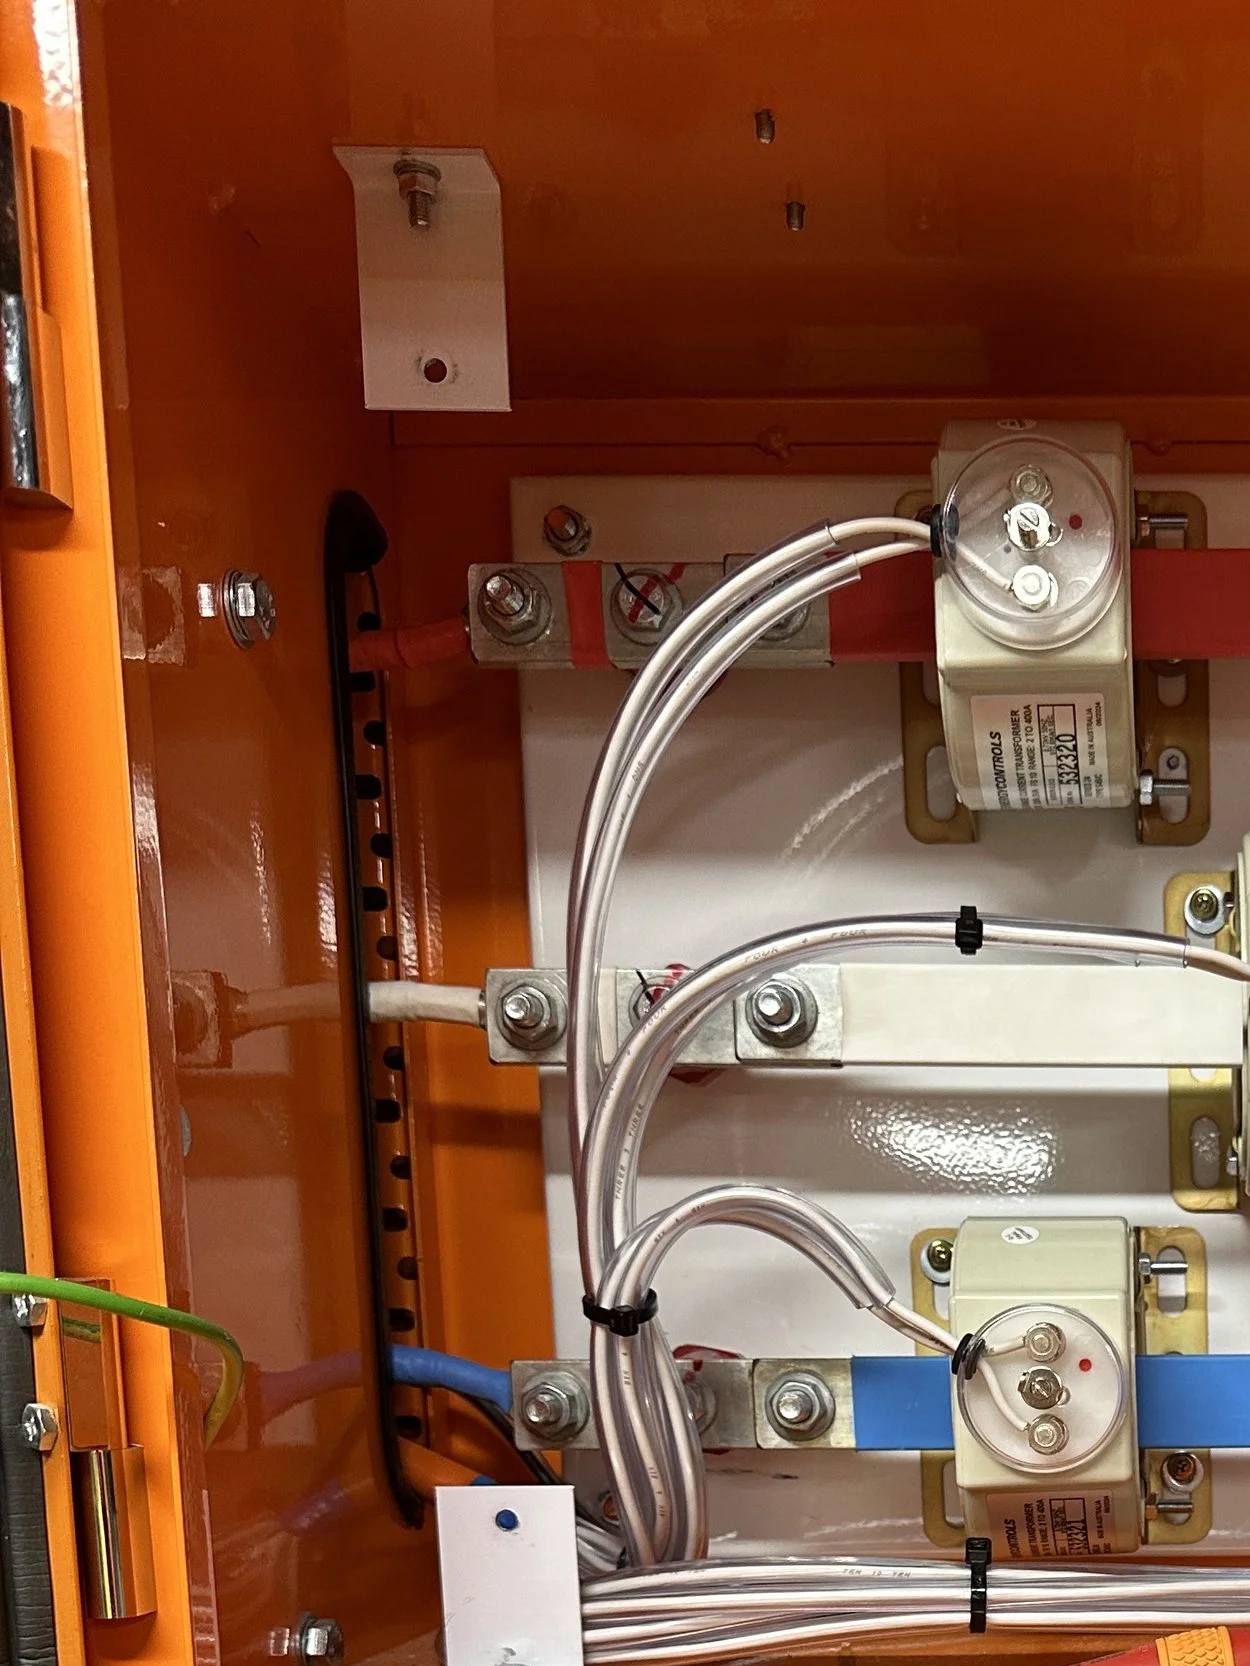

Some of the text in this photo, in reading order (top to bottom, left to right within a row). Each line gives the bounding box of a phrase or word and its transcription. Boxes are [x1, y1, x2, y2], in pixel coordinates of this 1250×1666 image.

[1023, 704, 1033, 725] 400A
[1025, 726, 1034, 737] TO
[1085, 708, 1094, 743] AUSTRALIA
[1010, 709, 1023, 771] TRANSFORMER
[1056, 733, 1079, 785] 532320
[743, 946, 779, 964] FOUR
[830, 927, 868, 939] FOUR
[641, 1005, 667, 1033] FOUR
[615, 1164, 626, 1200] THREE
[628, 1103, 645, 1138] THREE
[1023, 1503, 1036, 1544] TRANSFORMER
[842, 1567, 863, 1576] TEN
[891, 1570, 912, 1579] TEN
